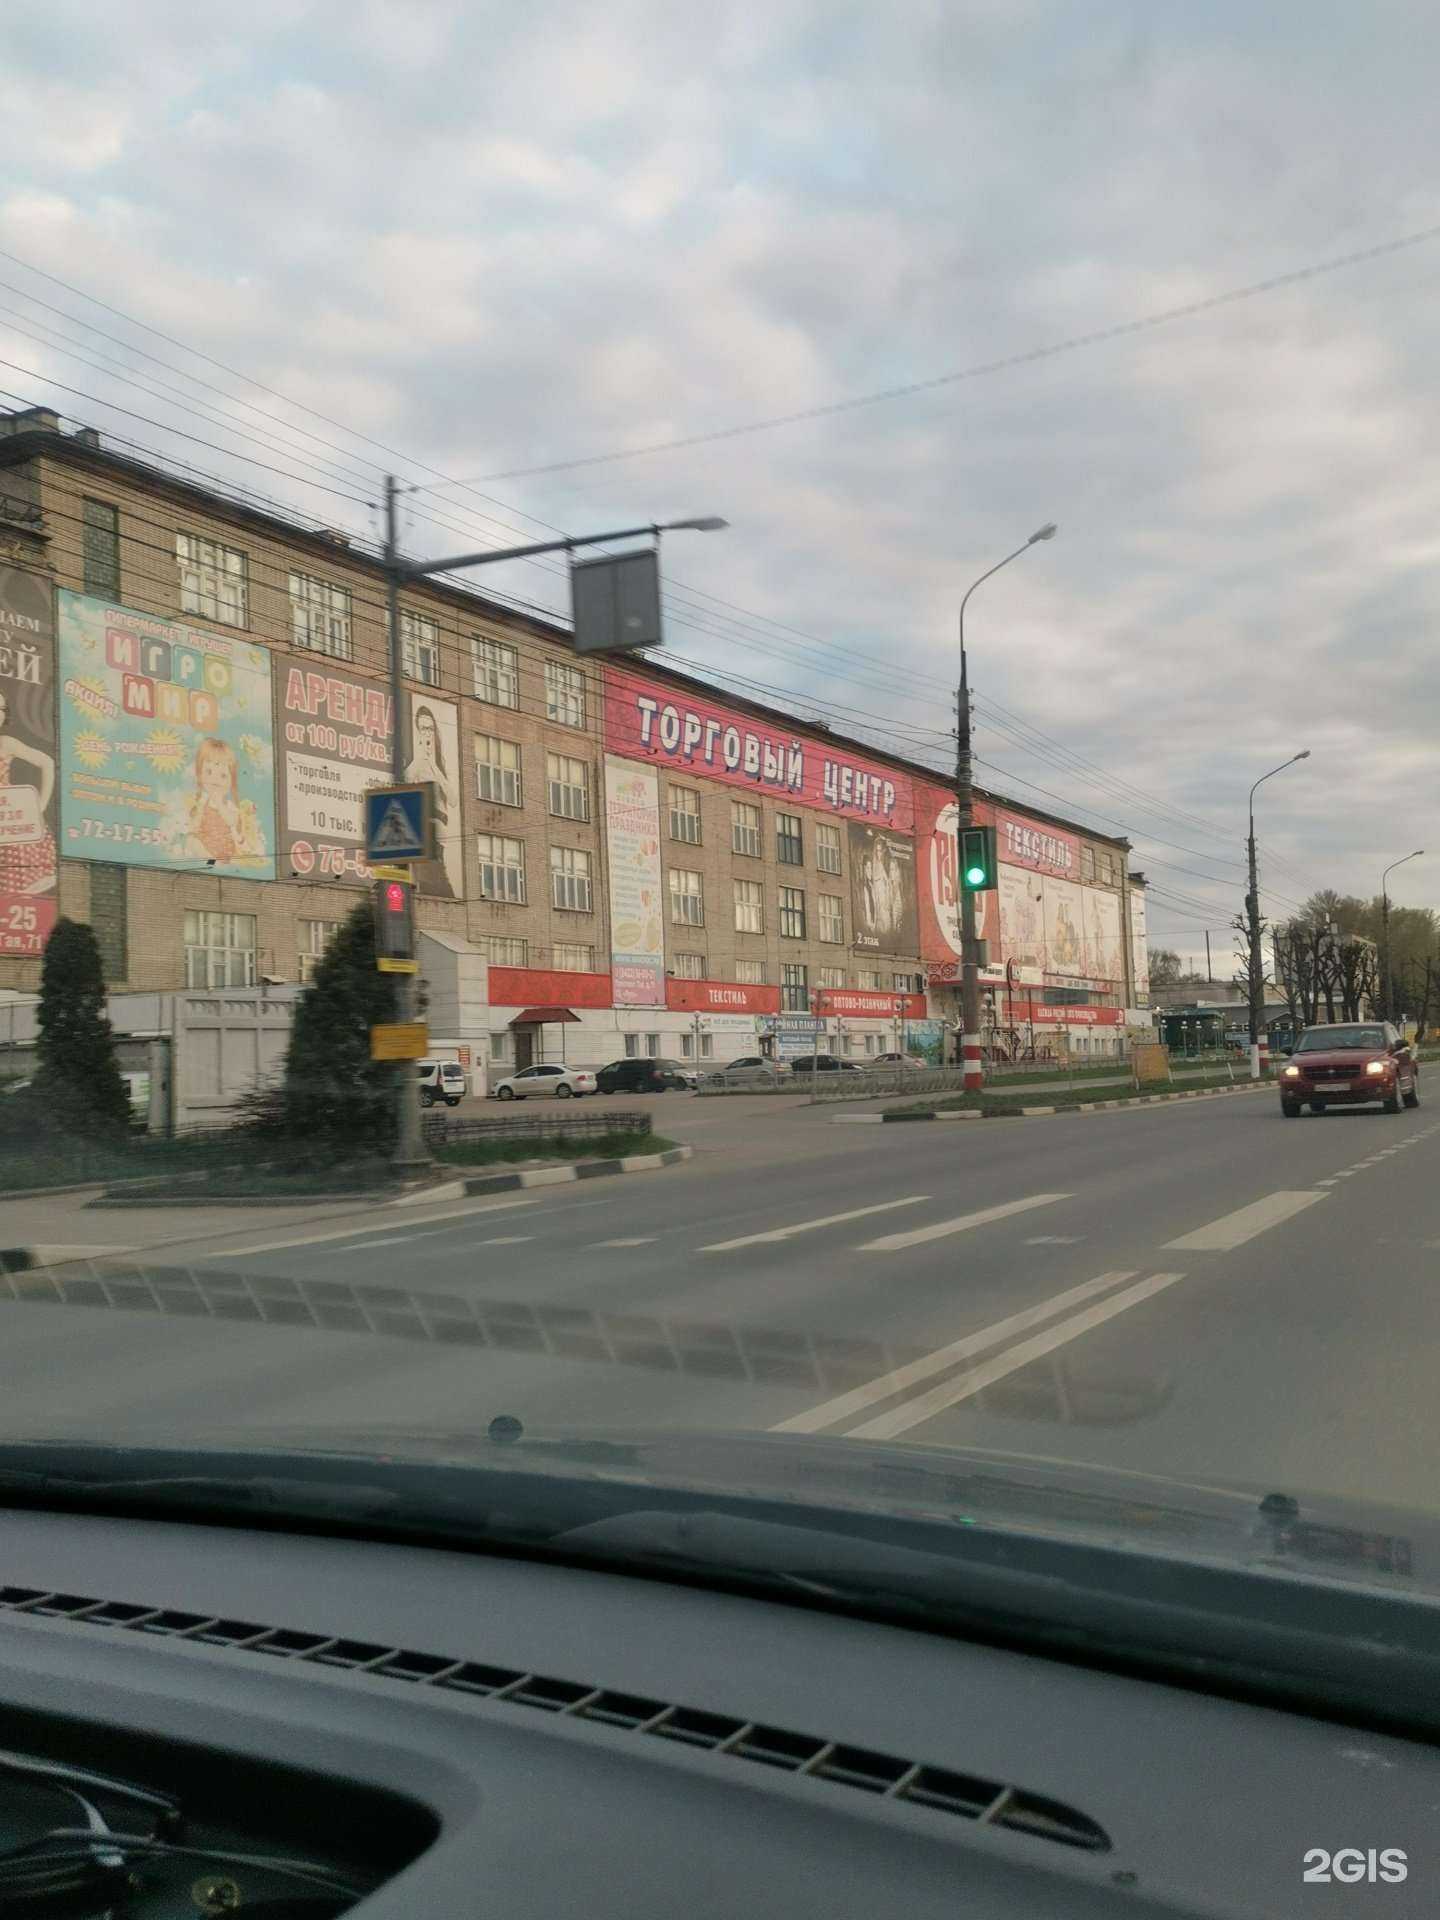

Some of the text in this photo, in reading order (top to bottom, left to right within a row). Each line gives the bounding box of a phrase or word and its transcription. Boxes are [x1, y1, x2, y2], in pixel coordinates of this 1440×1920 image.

[109, 631, 231, 691] ИГРО
[125, 676, 214, 727] МИР
[307, 723, 337, 751] 100
[636, 695, 896, 816] ТОРГОВЫЙ ЦЕНТР
[310, 810, 326, 829] 10
[329, 816, 357, 833] тыс.
[1005, 821, 1072, 868] ТЕКСТИЛЬ
[709, 989, 748, 1005] ТЕКСТИЛЬ
